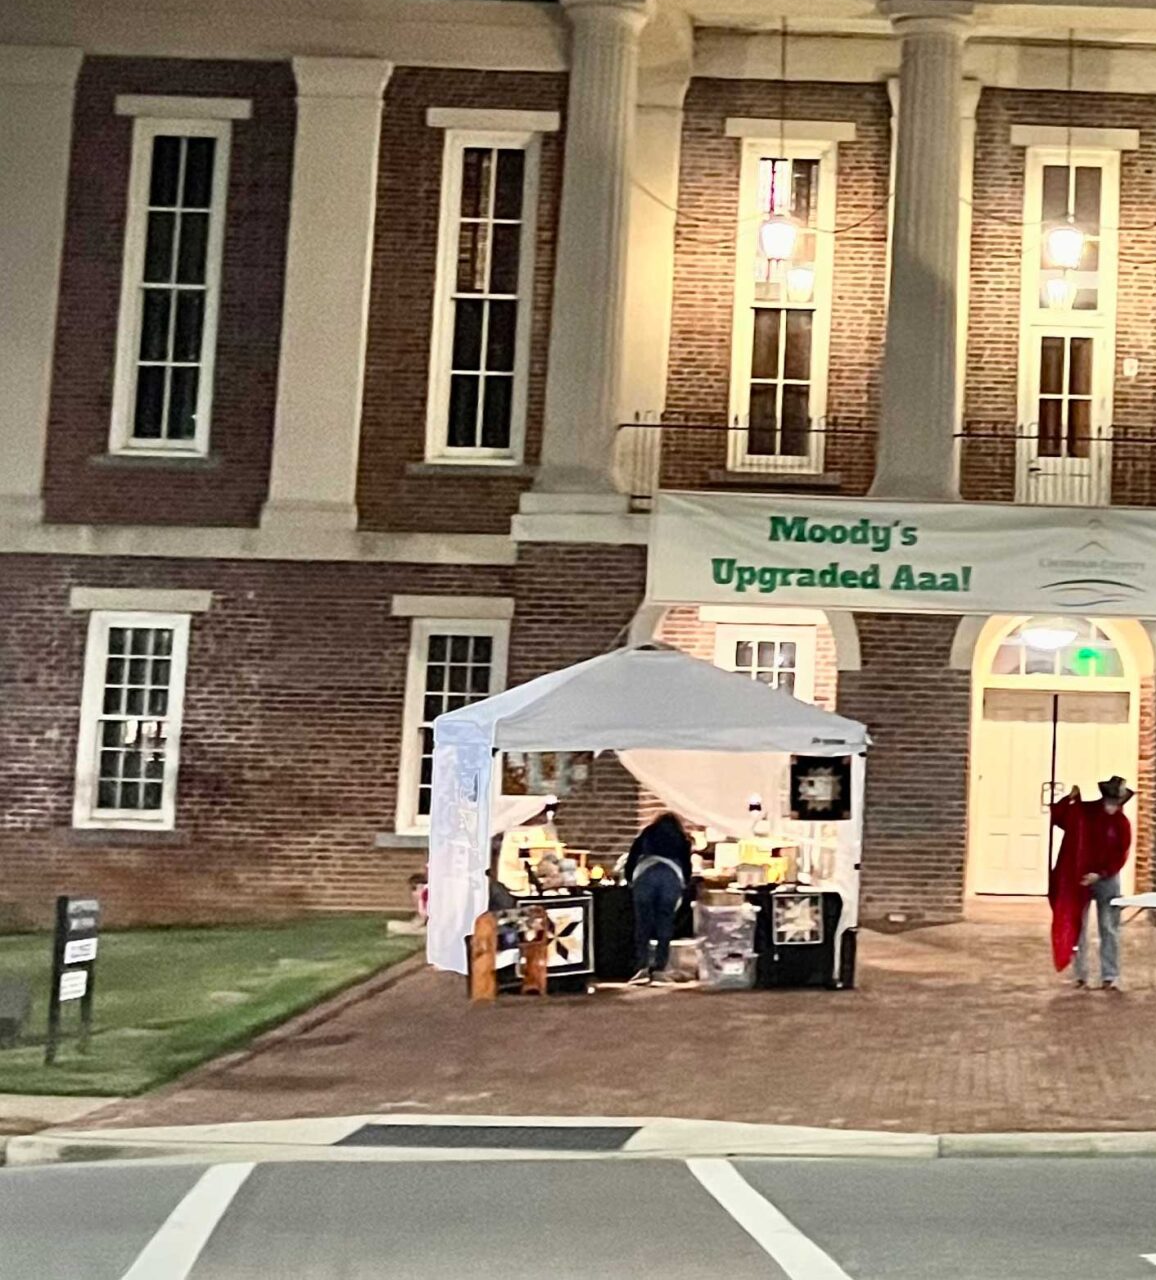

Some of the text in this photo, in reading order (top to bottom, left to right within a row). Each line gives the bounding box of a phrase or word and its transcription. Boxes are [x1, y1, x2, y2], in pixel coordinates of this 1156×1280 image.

[768, 516, 918, 551] Moody's
[711, 558, 972, 593] Upgraded Aaa!
